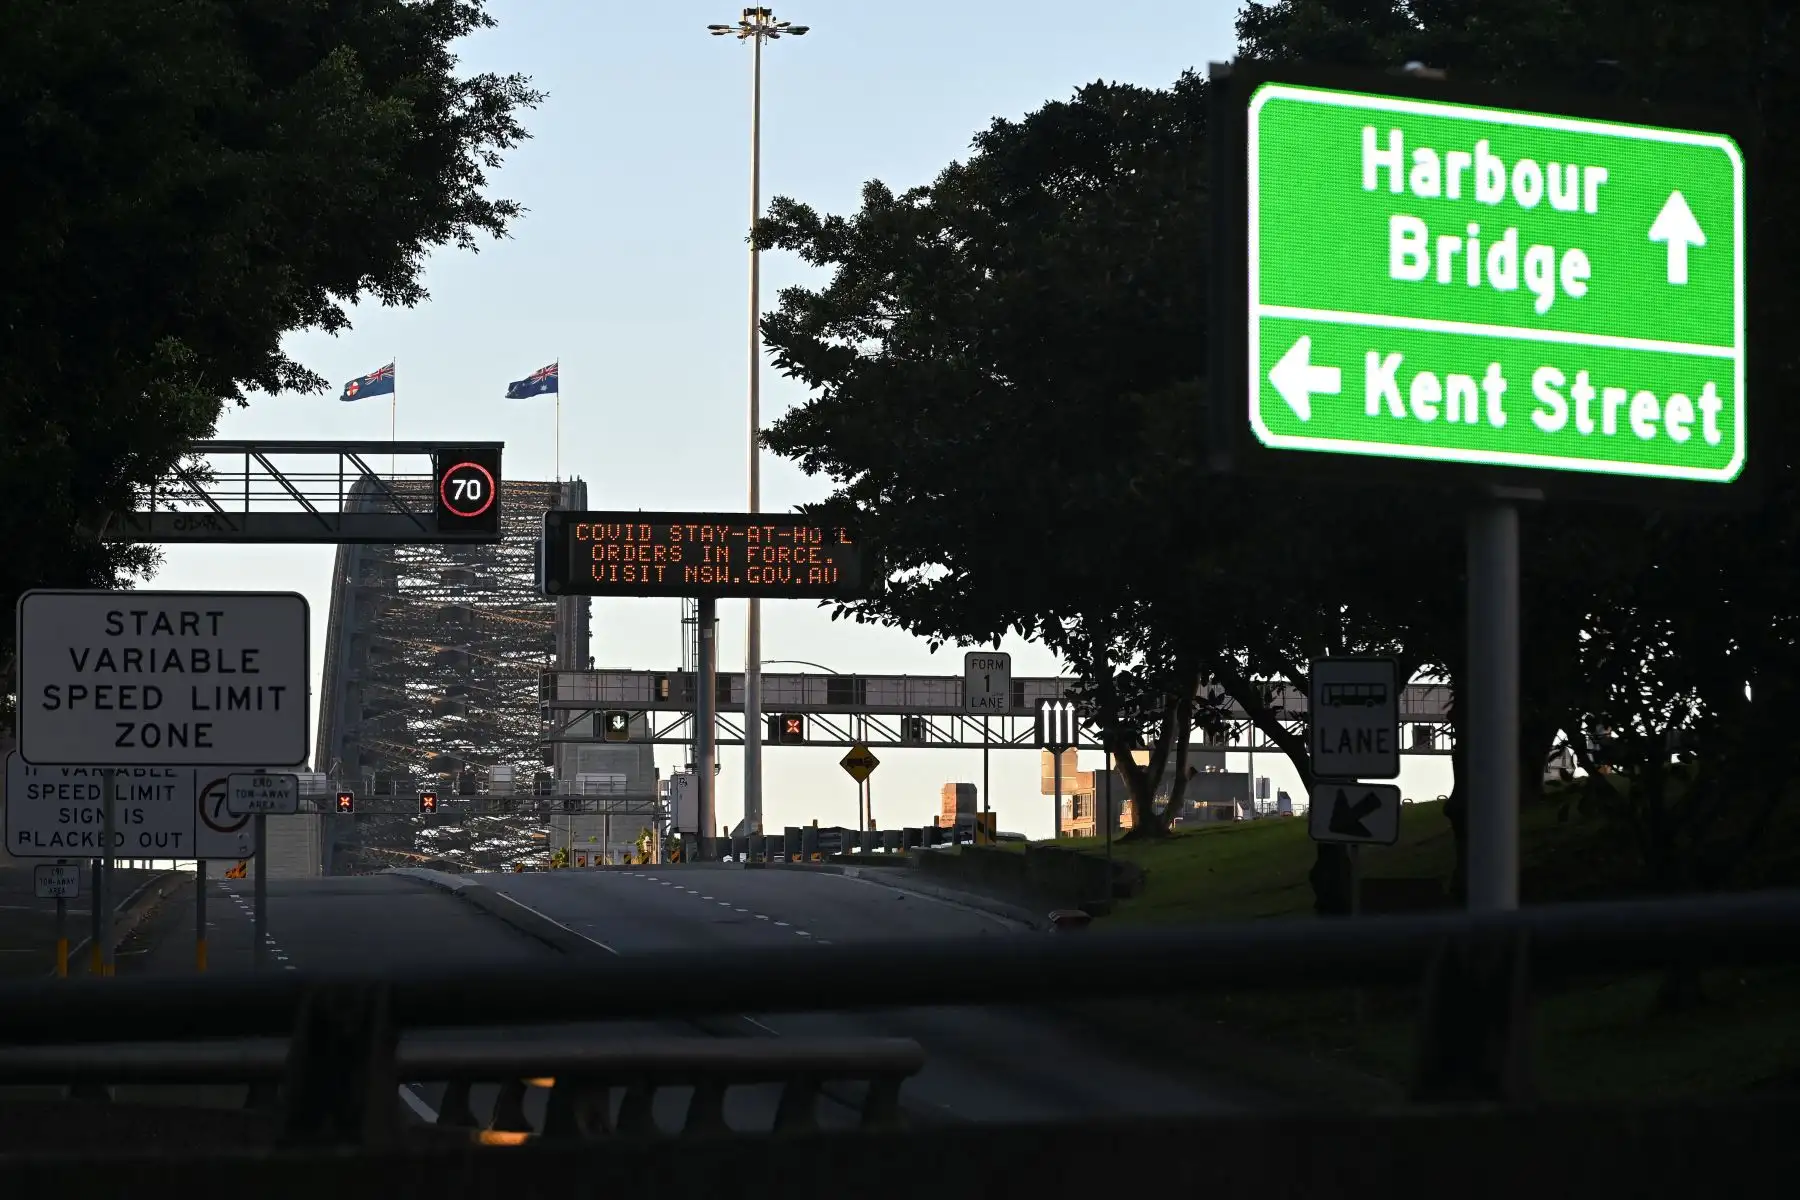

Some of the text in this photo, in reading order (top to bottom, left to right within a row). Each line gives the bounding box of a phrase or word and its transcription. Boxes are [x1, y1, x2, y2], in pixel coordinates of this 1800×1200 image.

[1361, 126, 1608, 214] Harbour
[1389, 214, 1591, 315] Bridge
[1365, 351, 1723, 446] Kent Street
[452, 479, 481, 500] 70
[576, 523, 852, 545] COVID STAY-AT-HOE
[592, 544, 833, 564] ORDERS IN FORCE.
[592, 564, 839, 584] VISIT NSW.GOV.AU
[105, 610, 225, 636] START
[69, 647, 261, 674] VARIABLE
[971, 658, 1004, 670] FORM
[984, 674, 990, 693] 1
[42, 684, 286, 712] SPEED LIMIT
[971, 696, 1004, 708] LANE
[115, 722, 214, 749] ZONE
[1320, 727, 1390, 754] LANE
[27, 783, 175, 801] SPEED LIMIT
[236, 789, 290, 799] TOW-AWAY
[124, 808, 144, 824] IS
[139, 832, 183, 848] OUT
